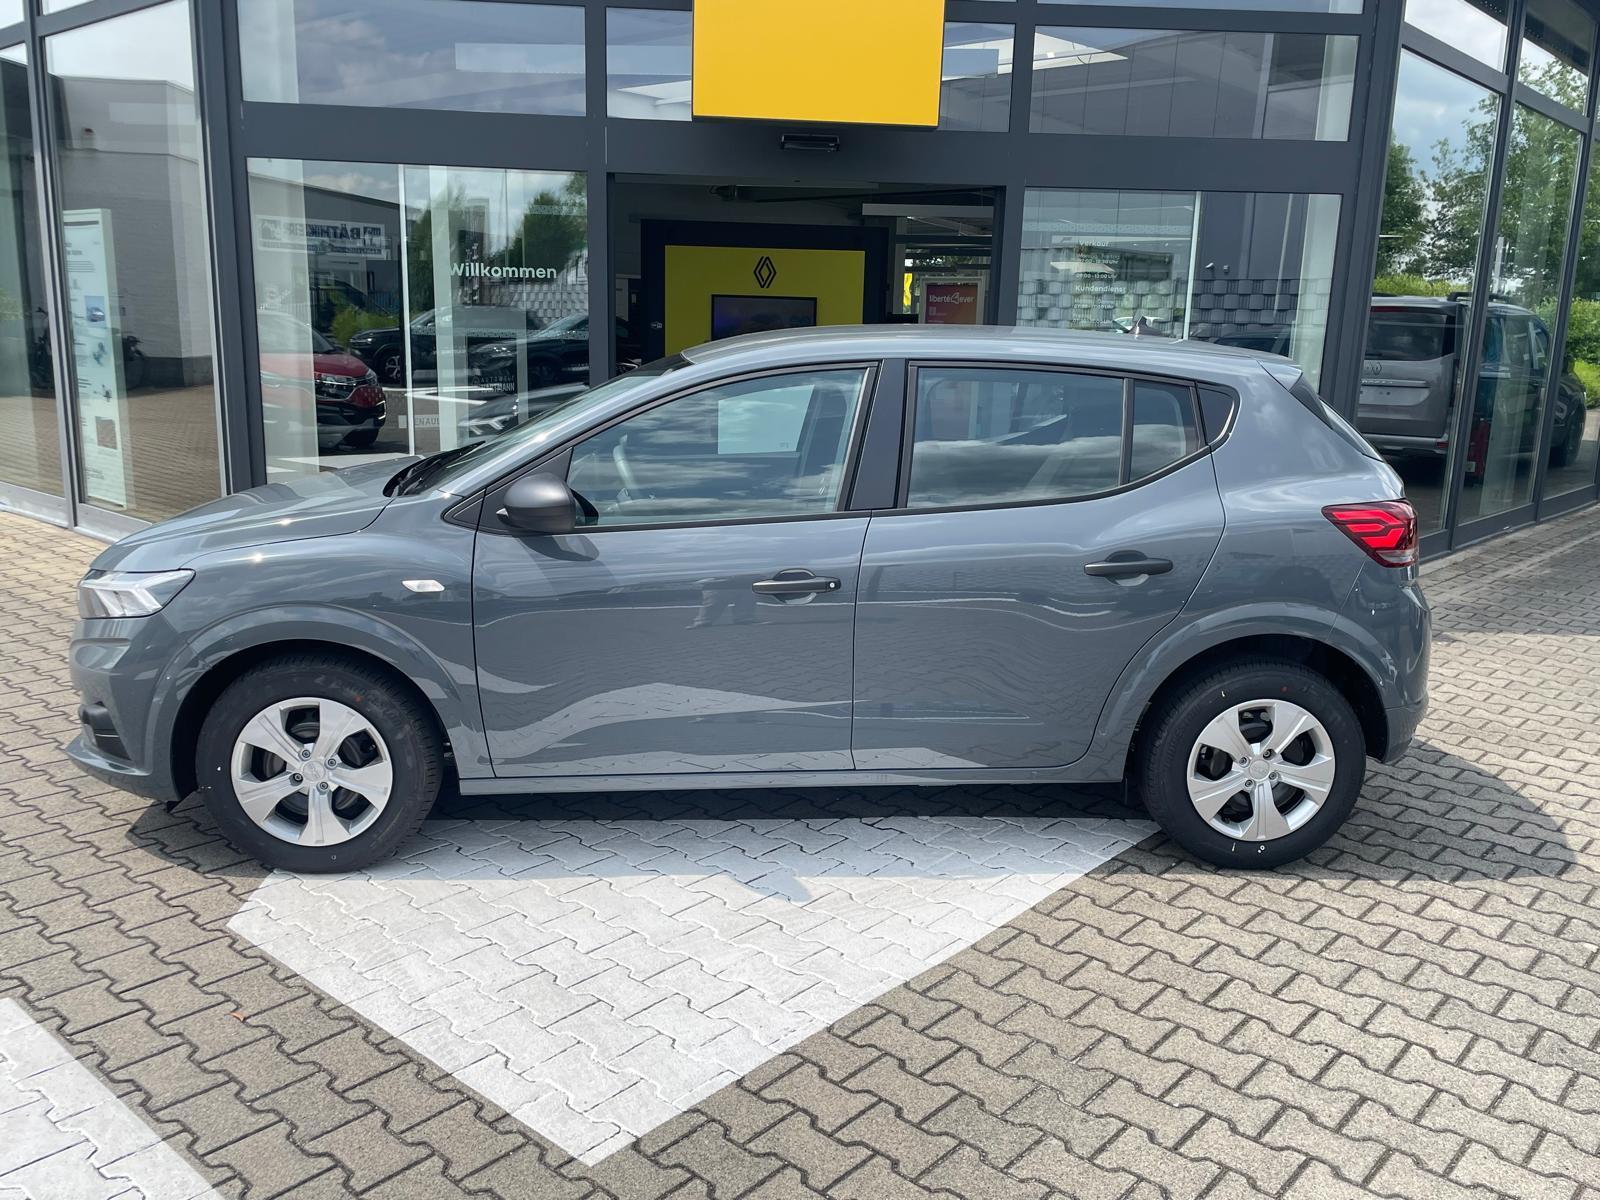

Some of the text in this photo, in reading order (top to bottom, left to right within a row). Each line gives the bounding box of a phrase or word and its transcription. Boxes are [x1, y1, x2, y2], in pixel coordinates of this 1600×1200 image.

[1079, 239, 1110, 247] Verkauf
[450, 262, 557, 279] Willkommen
[1075, 285, 1126, 293] Kundendienst
